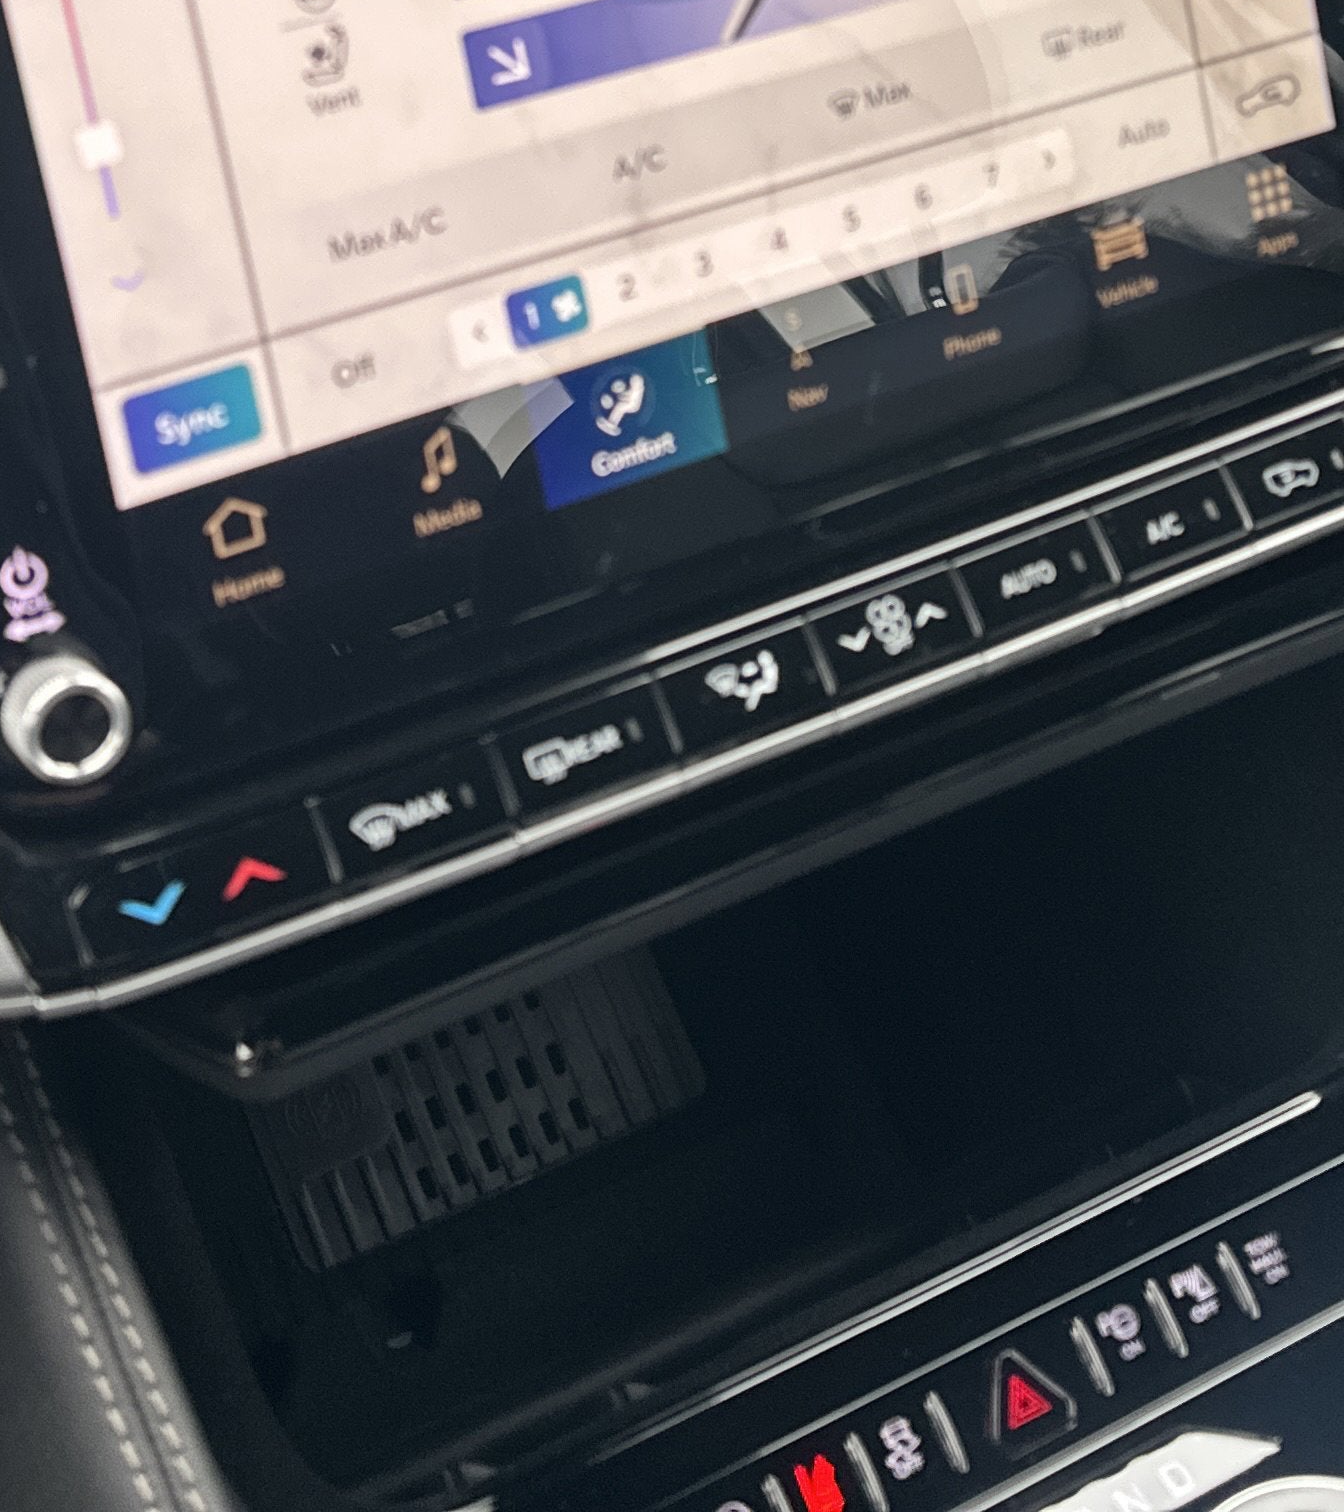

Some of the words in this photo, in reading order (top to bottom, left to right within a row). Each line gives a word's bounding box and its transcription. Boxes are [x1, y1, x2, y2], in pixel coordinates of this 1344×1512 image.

[612, 144, 668, 182] A/C
[389, 205, 449, 244] A/C
[617, 273, 638, 303] 2
[694, 249, 714, 278] 3
[155, 403, 229, 448] Sync
[591, 431, 678, 478] Comfort
[1146, 510, 1185, 545] A/C
[1159, 1460, 1196, 1499] D
